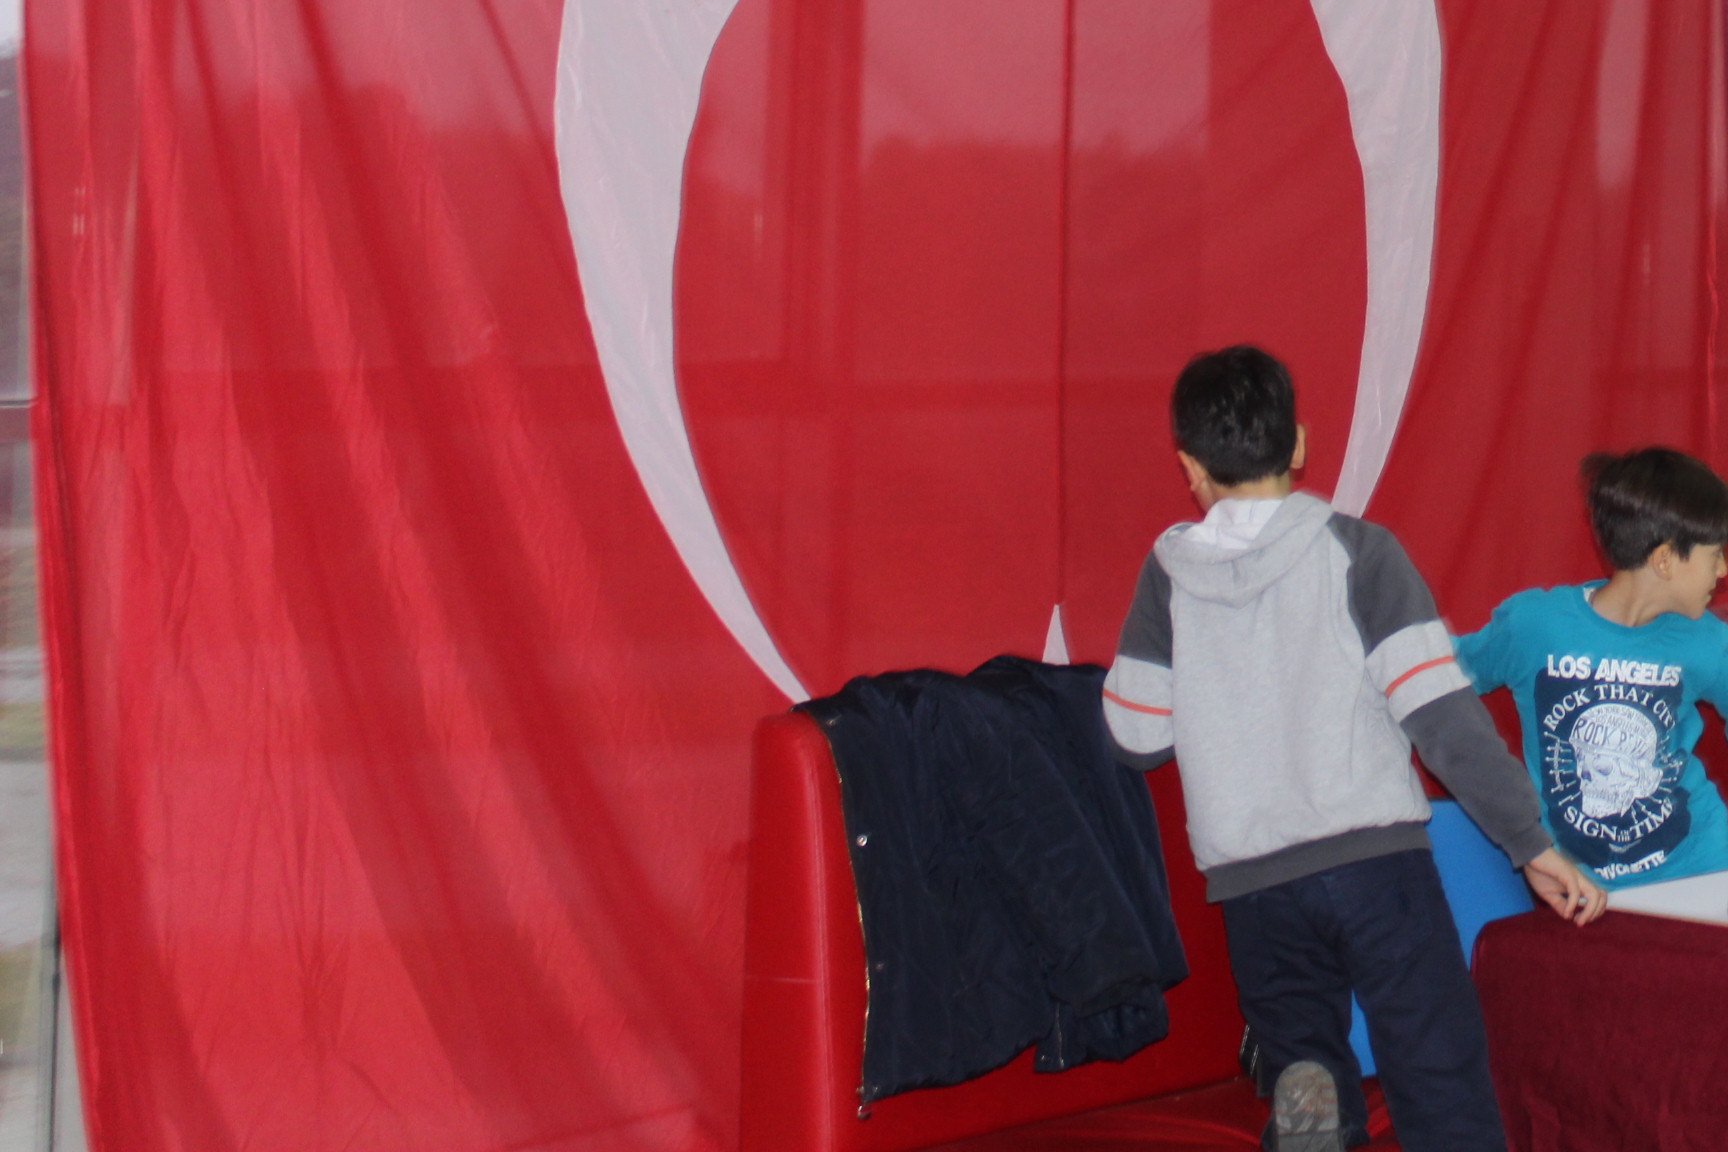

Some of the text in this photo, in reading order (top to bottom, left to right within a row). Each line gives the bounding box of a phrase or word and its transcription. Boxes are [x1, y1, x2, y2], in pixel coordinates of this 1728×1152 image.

[1547, 654, 1682, 687] LOS ANGELES
[1543, 688, 1591, 732] ROCK
[1594, 684, 1653, 706] THAT
[1572, 717, 1617, 747] ROCK
[1563, 806, 1617, 841] SIGN
